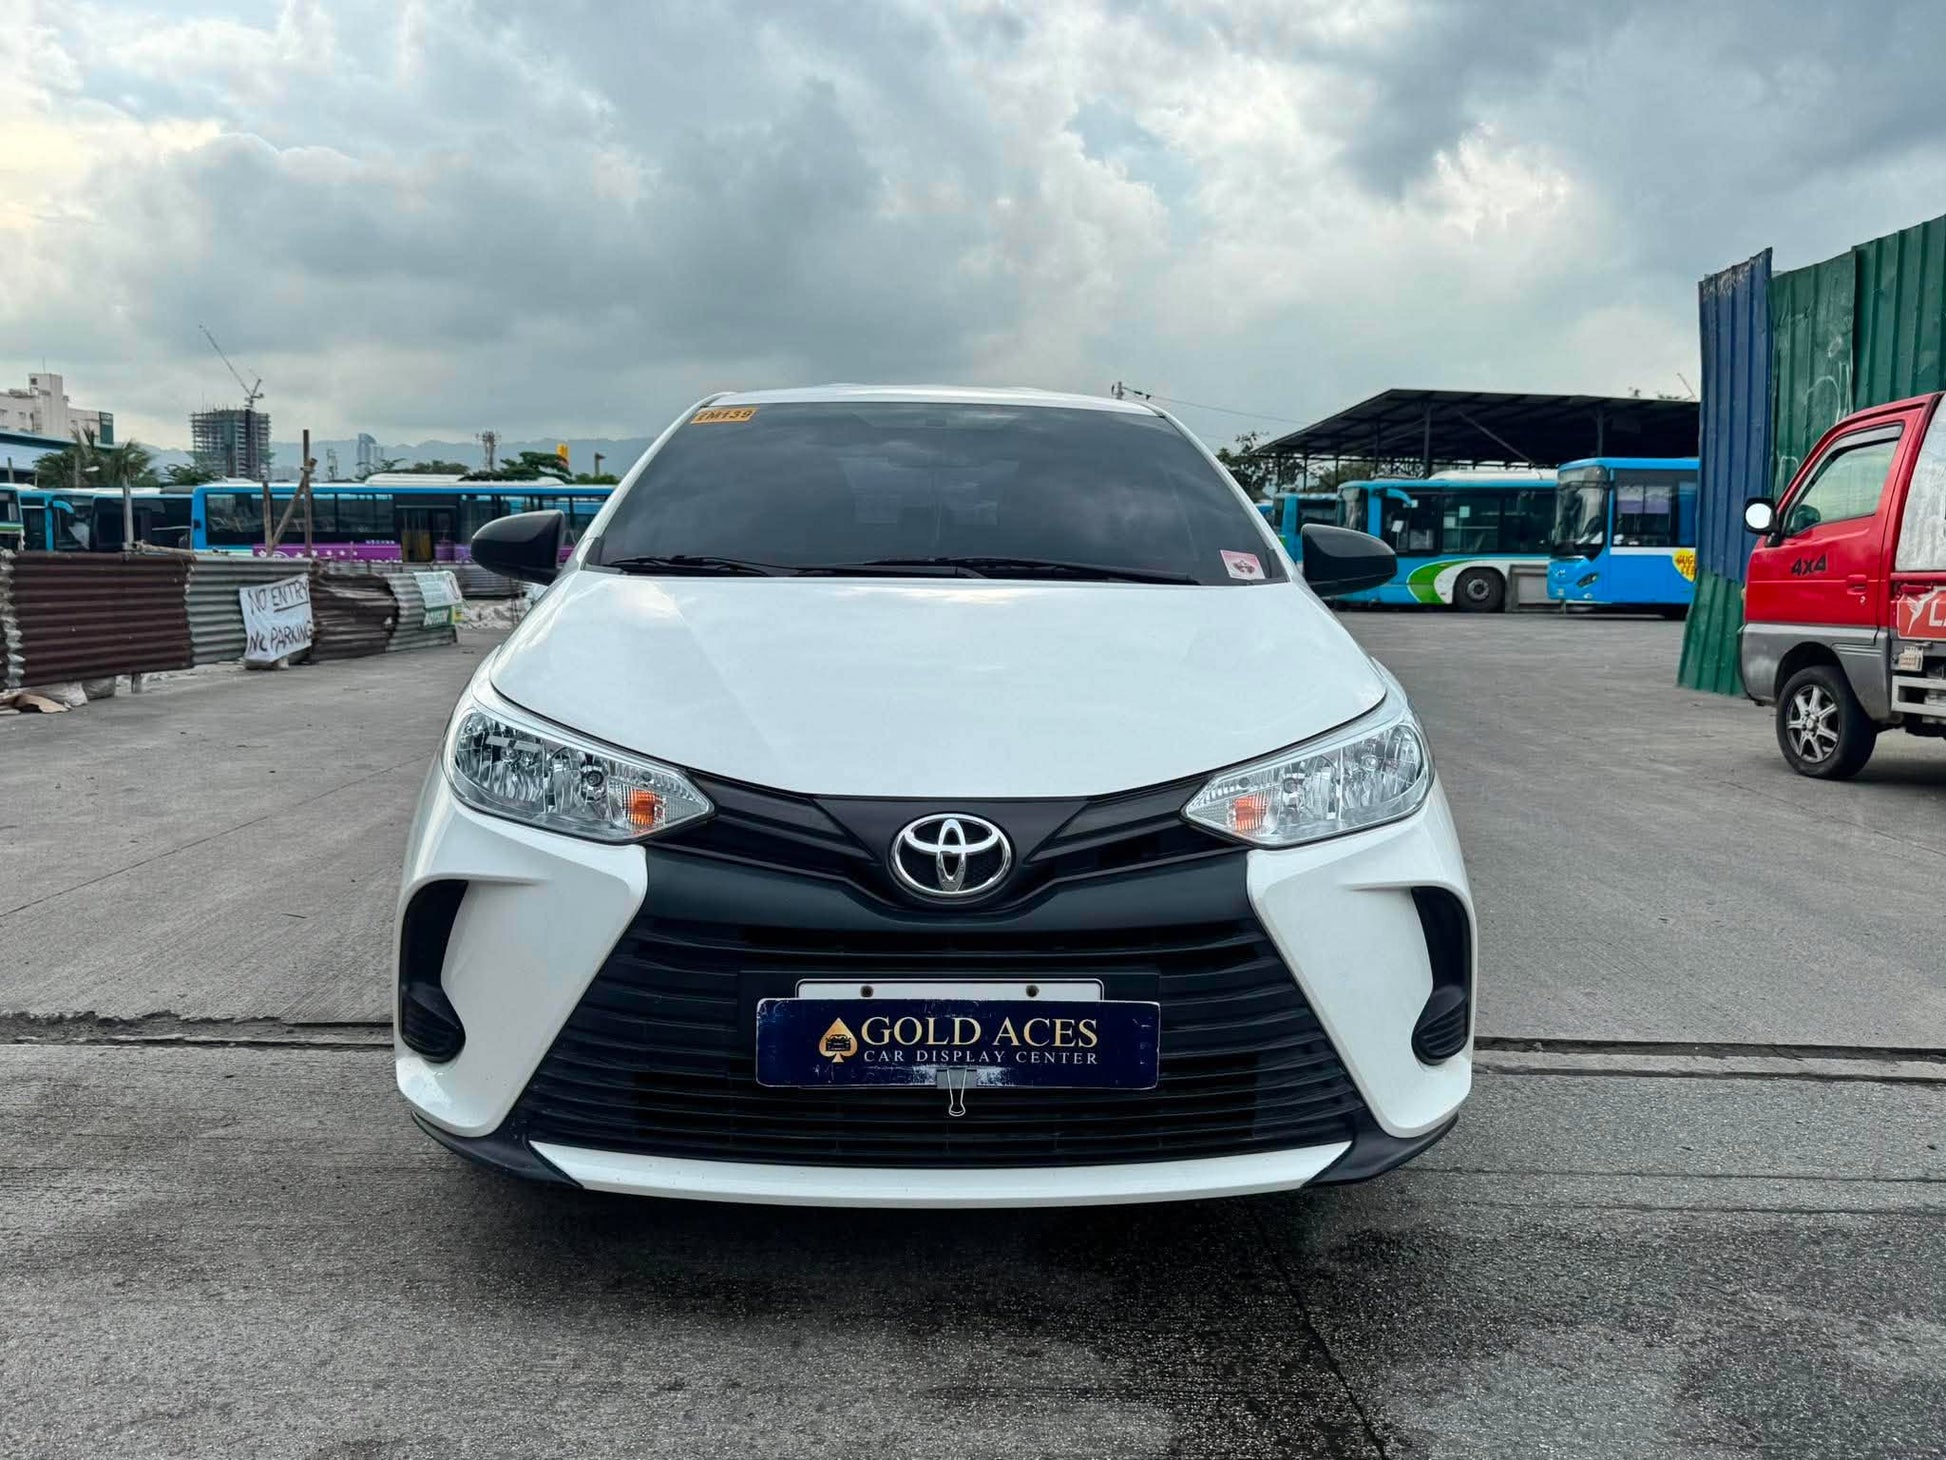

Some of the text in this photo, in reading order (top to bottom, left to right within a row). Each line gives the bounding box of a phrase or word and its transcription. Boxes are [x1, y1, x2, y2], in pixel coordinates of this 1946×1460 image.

[1791, 553, 1827, 576] 4x4
[248, 580, 310, 616] NO ENTRY
[270, 620, 313, 654] PARKING
[861, 1016, 1099, 1048] GOLD ACES
[863, 1050, 1099, 1065] CAR DISPLAY CENTER
